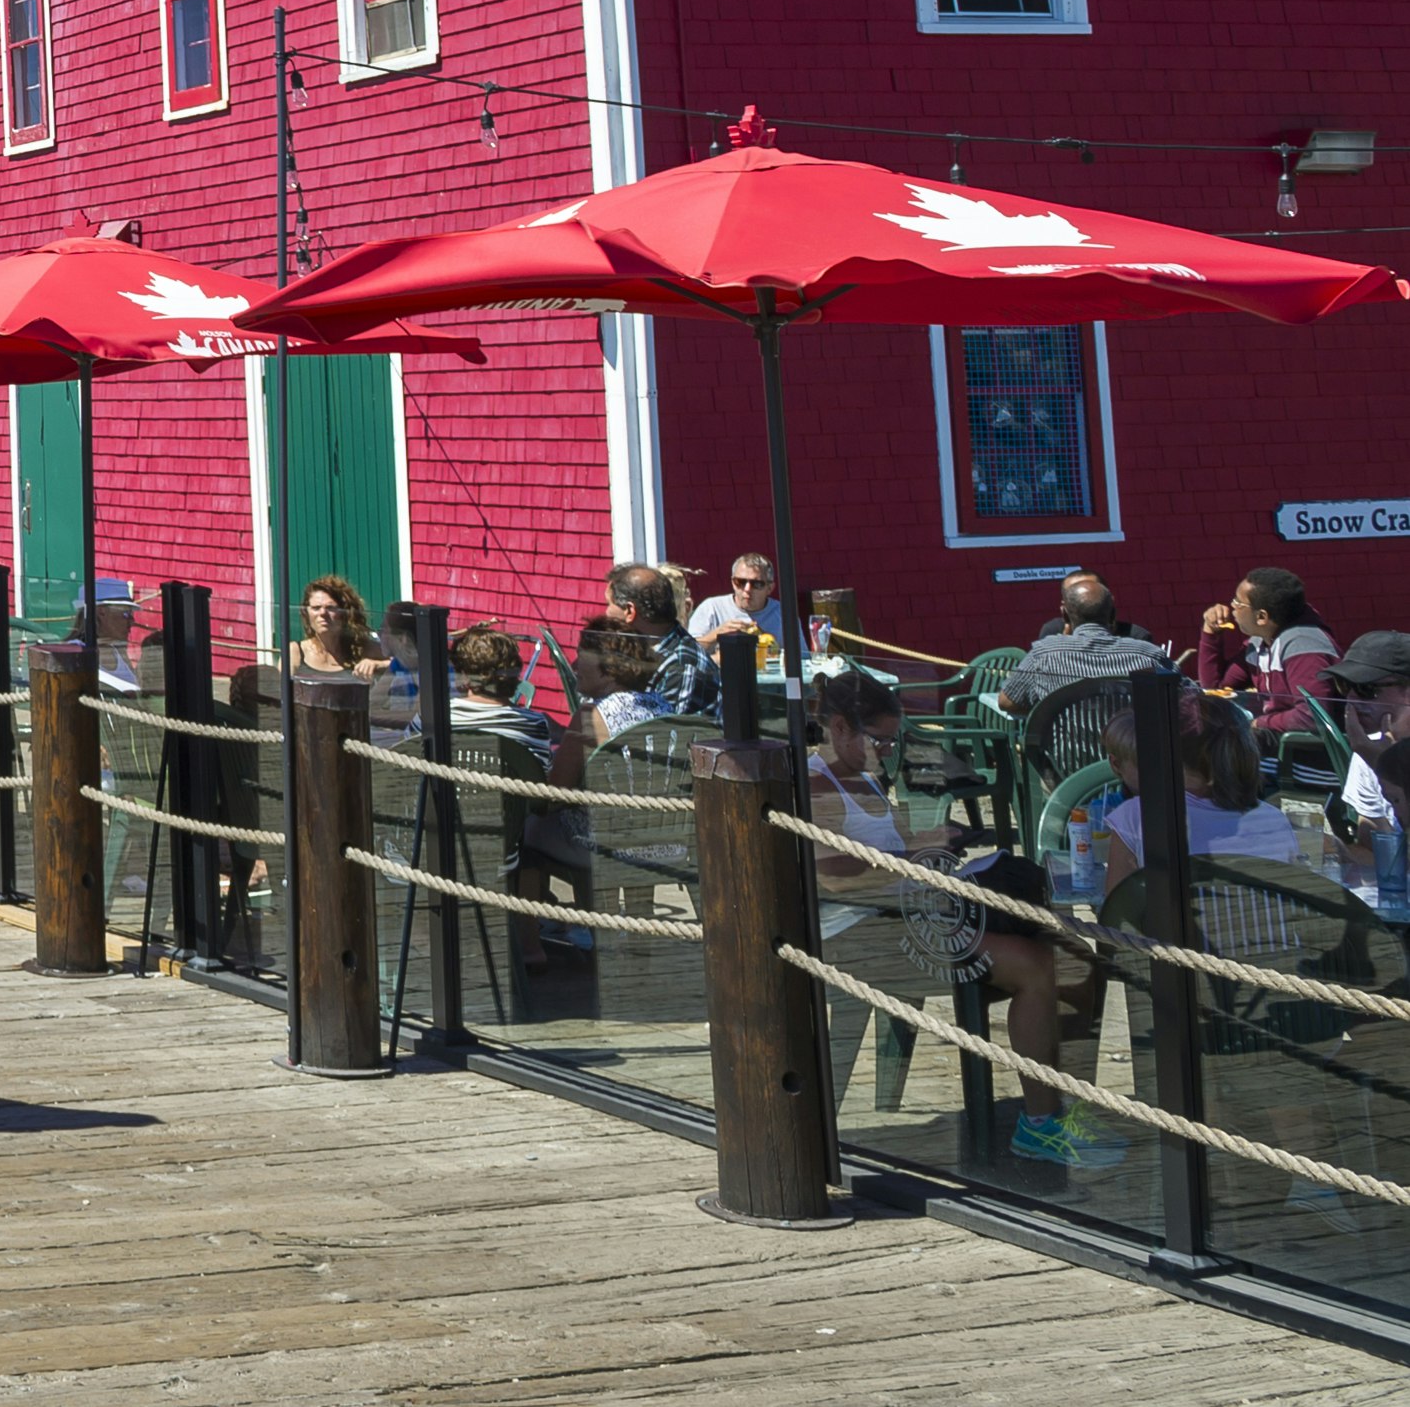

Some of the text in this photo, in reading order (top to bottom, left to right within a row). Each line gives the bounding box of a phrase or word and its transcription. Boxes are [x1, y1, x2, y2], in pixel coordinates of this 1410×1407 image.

[198, 330, 232, 338] MOLSON
[1296, 510, 1365, 534] Snow
[909, 912, 977, 953] FACTORY
[898, 935, 995, 984] RESTAURANT
